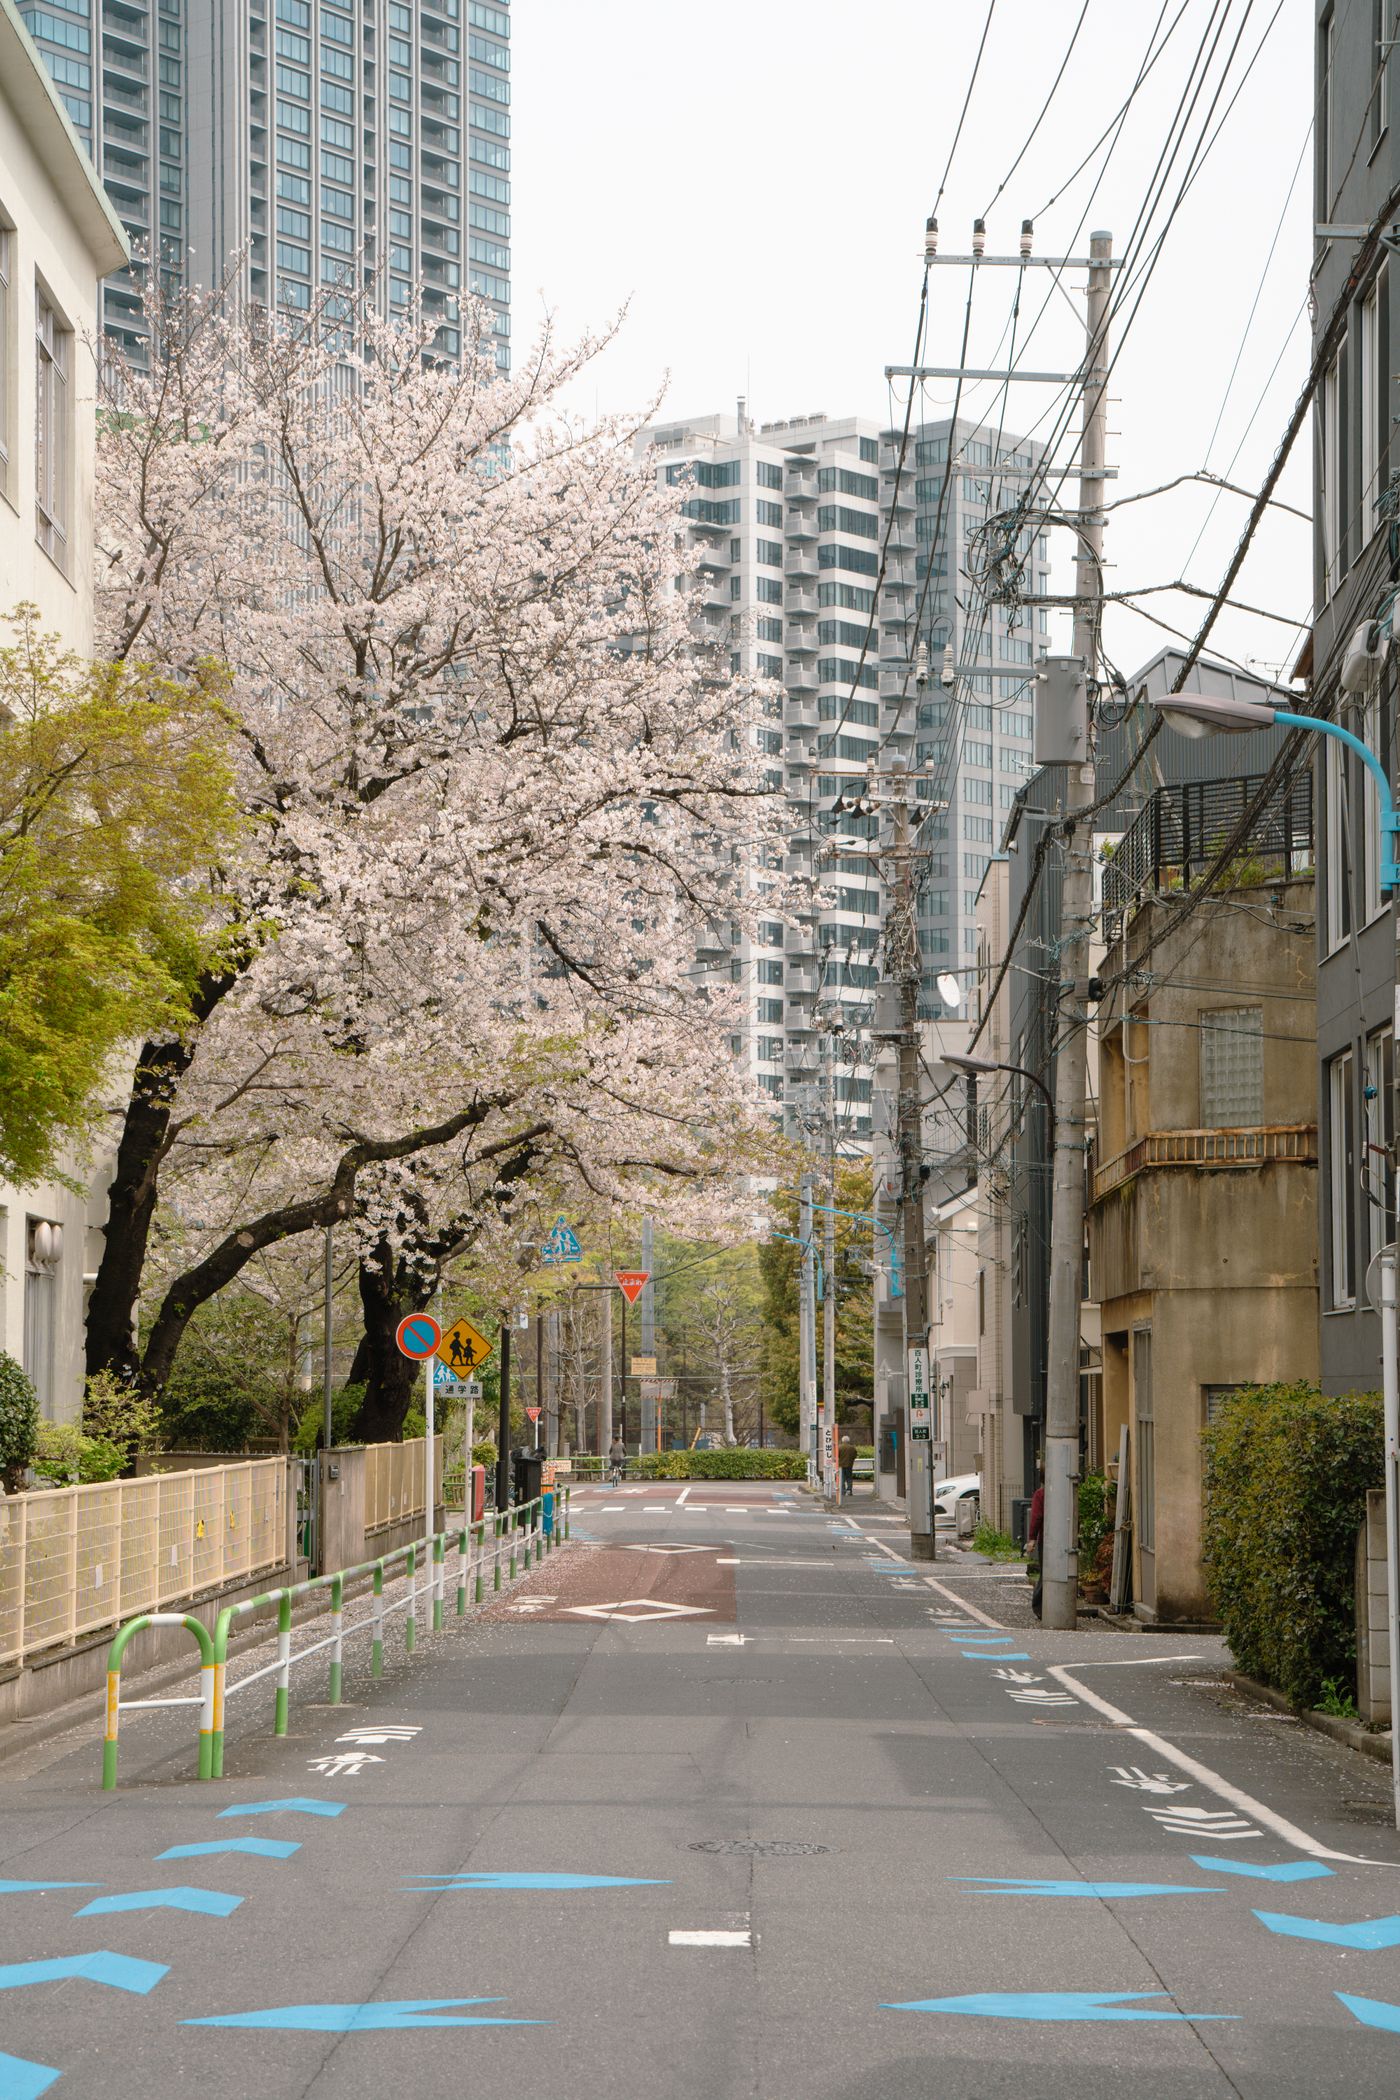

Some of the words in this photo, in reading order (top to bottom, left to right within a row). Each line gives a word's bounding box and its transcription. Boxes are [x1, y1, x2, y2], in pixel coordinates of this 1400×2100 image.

[914, 1349, 923, 1393] 百人町診療所
[445, 1384, 479, 1395] 通学路
